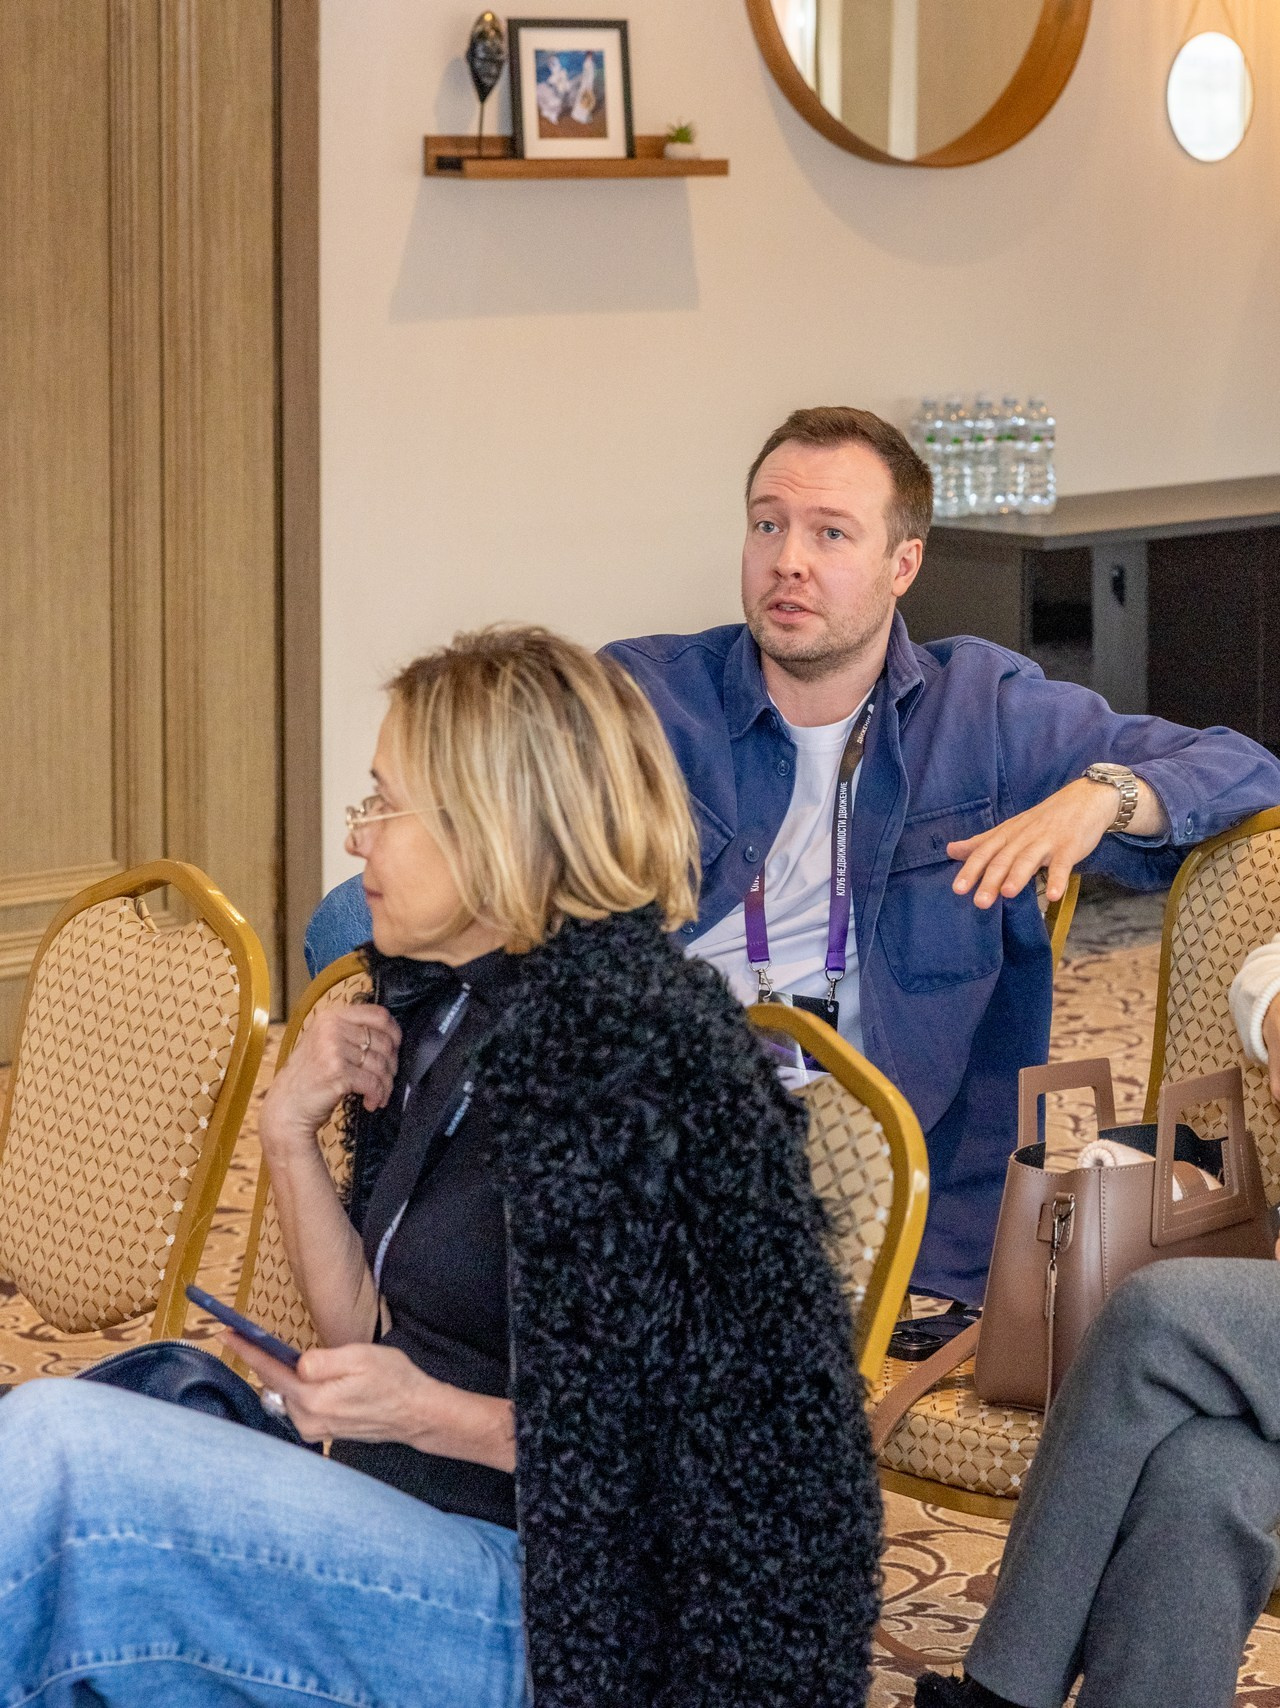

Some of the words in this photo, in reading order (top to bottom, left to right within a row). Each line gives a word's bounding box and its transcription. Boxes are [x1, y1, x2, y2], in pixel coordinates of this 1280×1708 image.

[838, 781, 848, 819] ДВИЖЕНИЕ
[837, 819, 847, 877] НЕДВИЖИМОСТИ
[836, 877, 846, 897] КЛУБ
